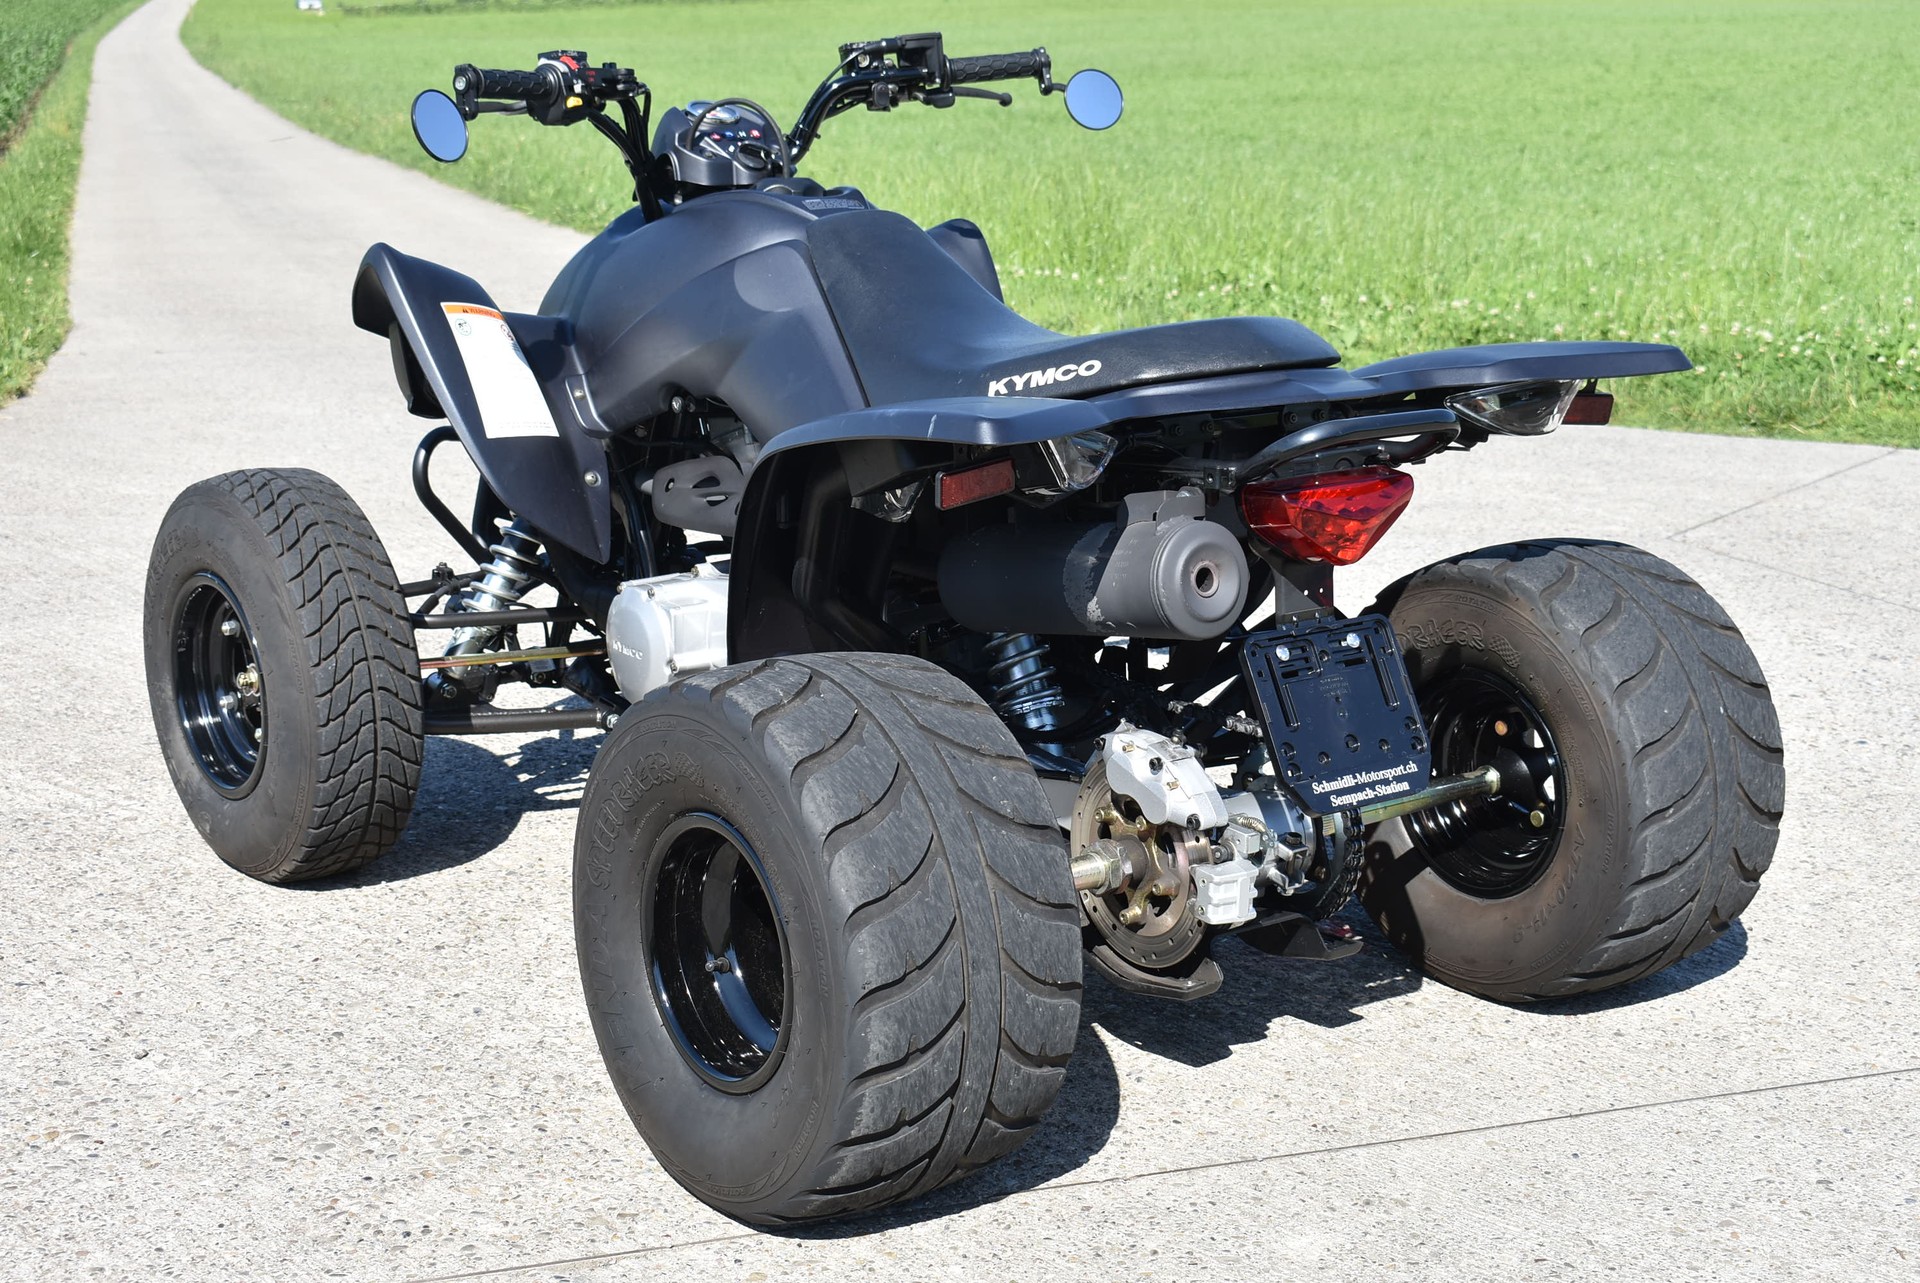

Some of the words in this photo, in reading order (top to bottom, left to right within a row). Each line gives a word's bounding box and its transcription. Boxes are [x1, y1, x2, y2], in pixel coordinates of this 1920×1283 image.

[987, 360, 1102, 397] KYMCO
[1311, 761, 1419, 795] Schmidli-Motorsport.ch
[1329, 781, 1411, 807] Sempach-Station
